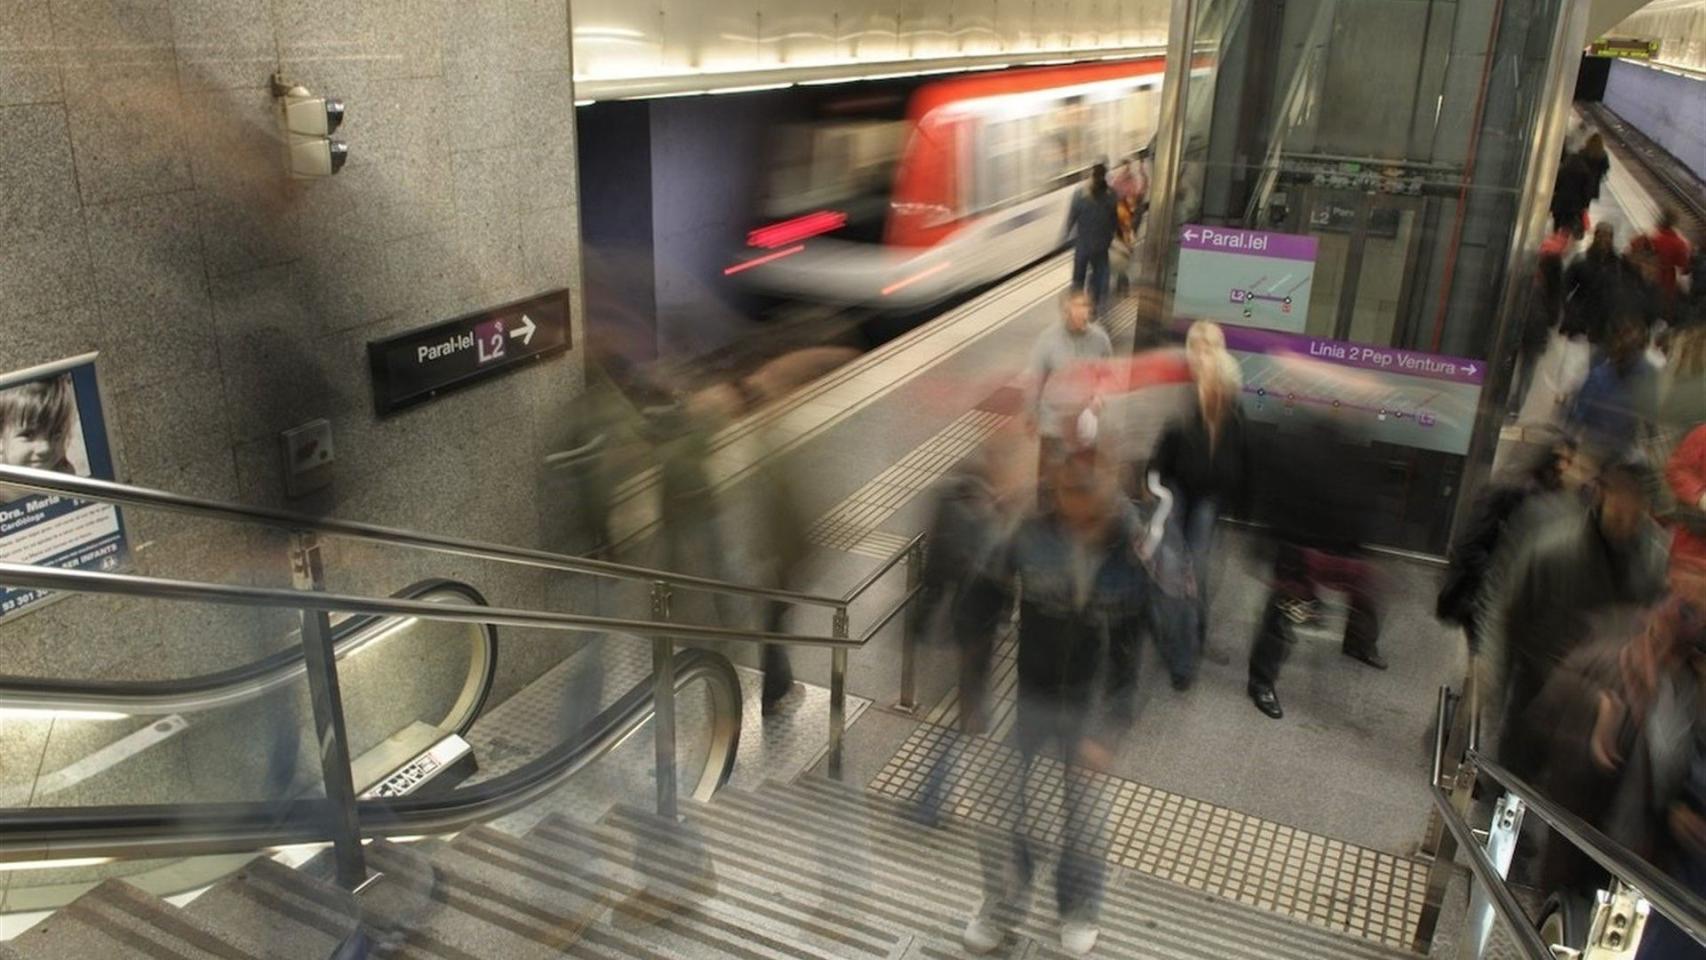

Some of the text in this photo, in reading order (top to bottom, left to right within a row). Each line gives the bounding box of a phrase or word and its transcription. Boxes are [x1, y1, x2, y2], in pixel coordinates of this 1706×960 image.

[478, 334, 505, 363] L2
[1349, 347, 1360, 361] 2
[1362, 349, 1393, 366] Pep
[1396, 352, 1456, 375] Ventura
[0, 509, 24, 522] Dra.
[25, 495, 60, 512] Maria
[80, 543, 118, 564] INFANTS
[16, 591, 34, 606] 301
